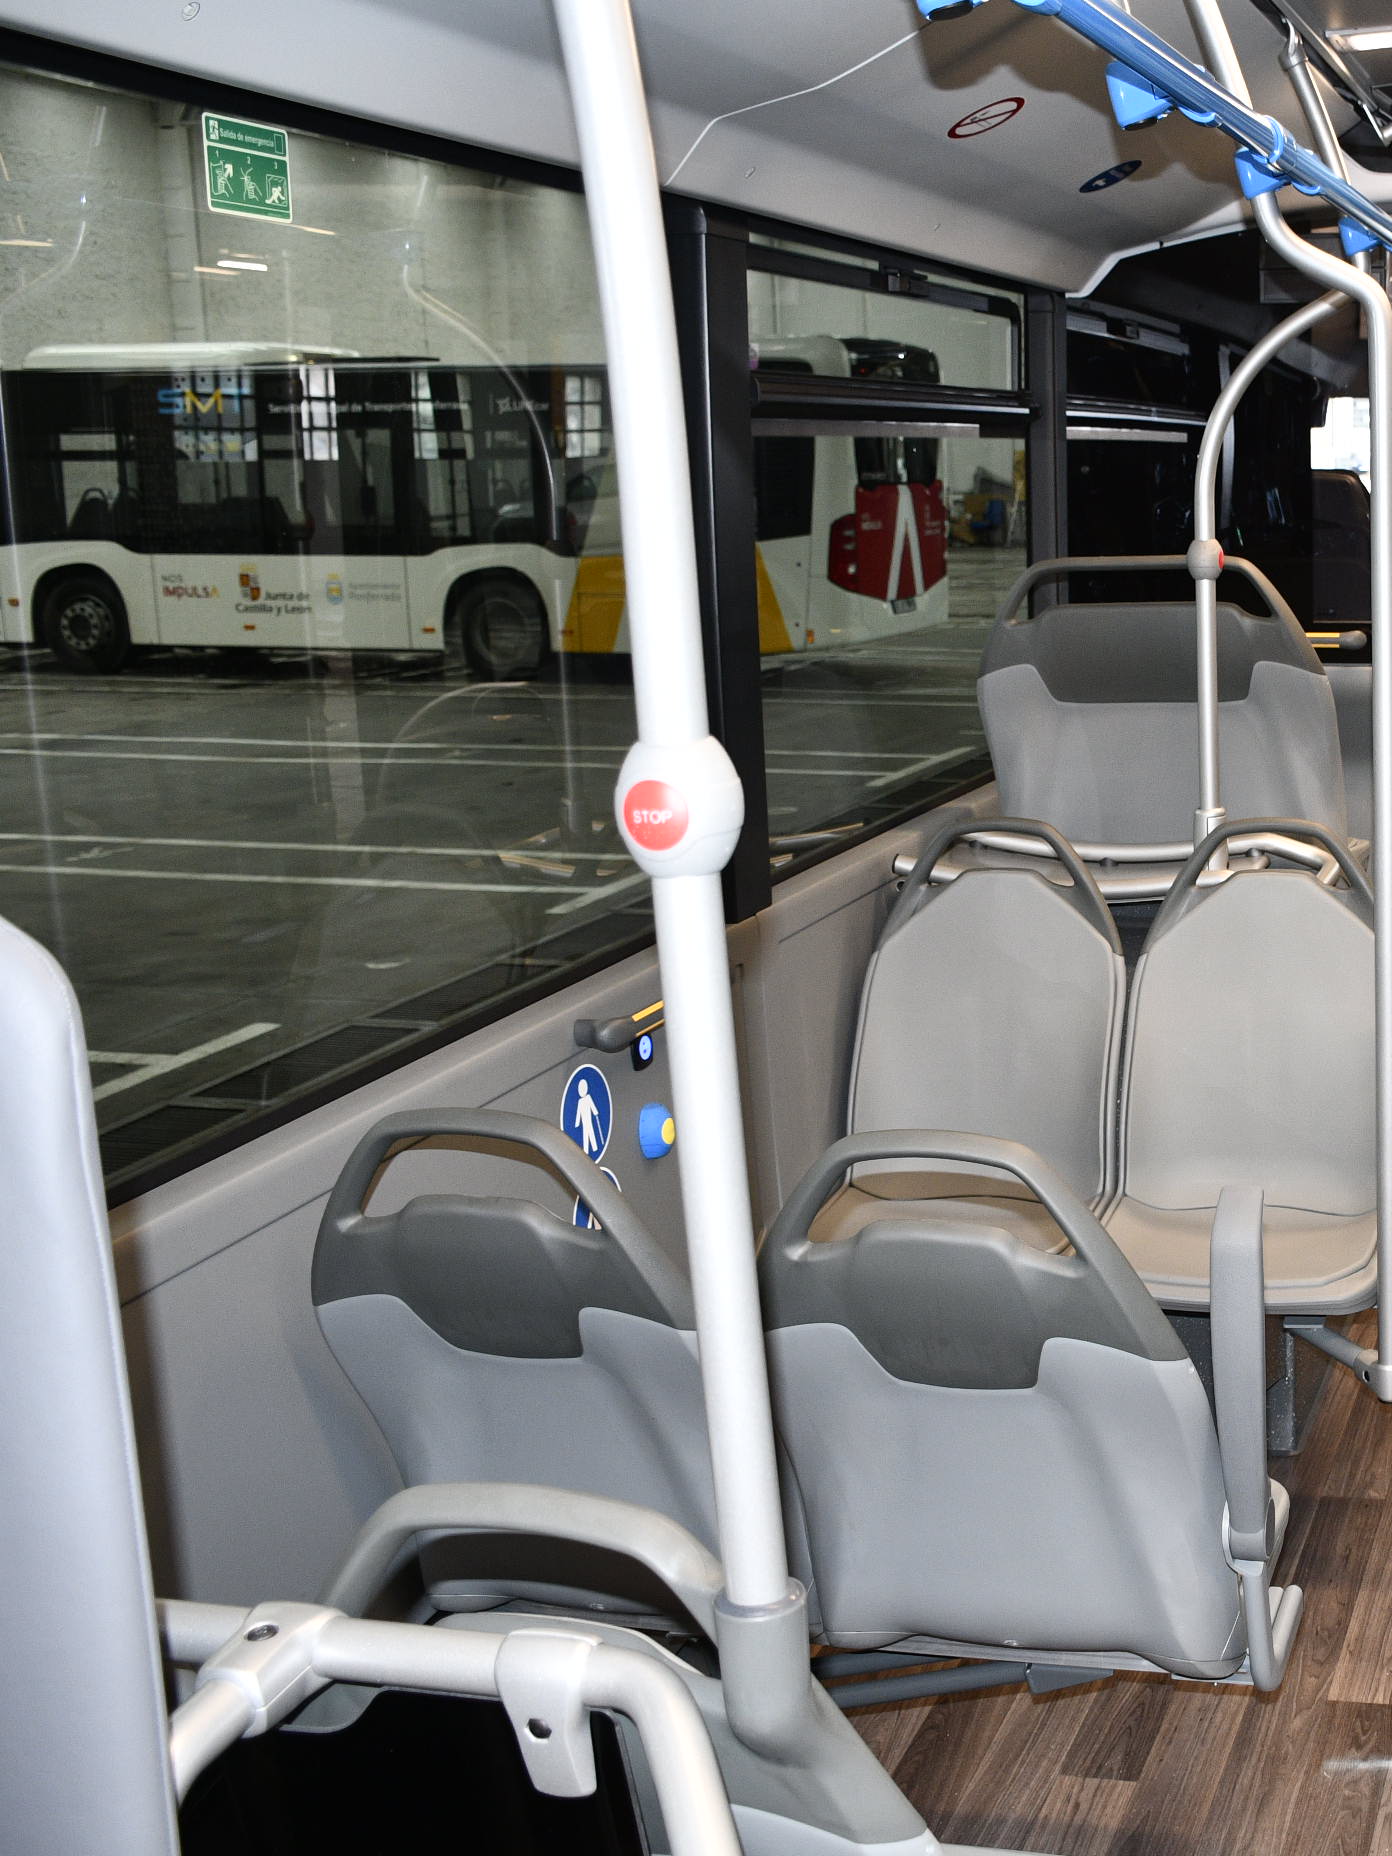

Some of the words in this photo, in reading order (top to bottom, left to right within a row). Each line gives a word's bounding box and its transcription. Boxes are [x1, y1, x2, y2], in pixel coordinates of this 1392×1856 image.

[220, 128, 236, 139] Salida
[163, 585, 220, 599] IMPULSA
[235, 603, 273, 614] Castilla
[633, 810, 673, 825] STOP
